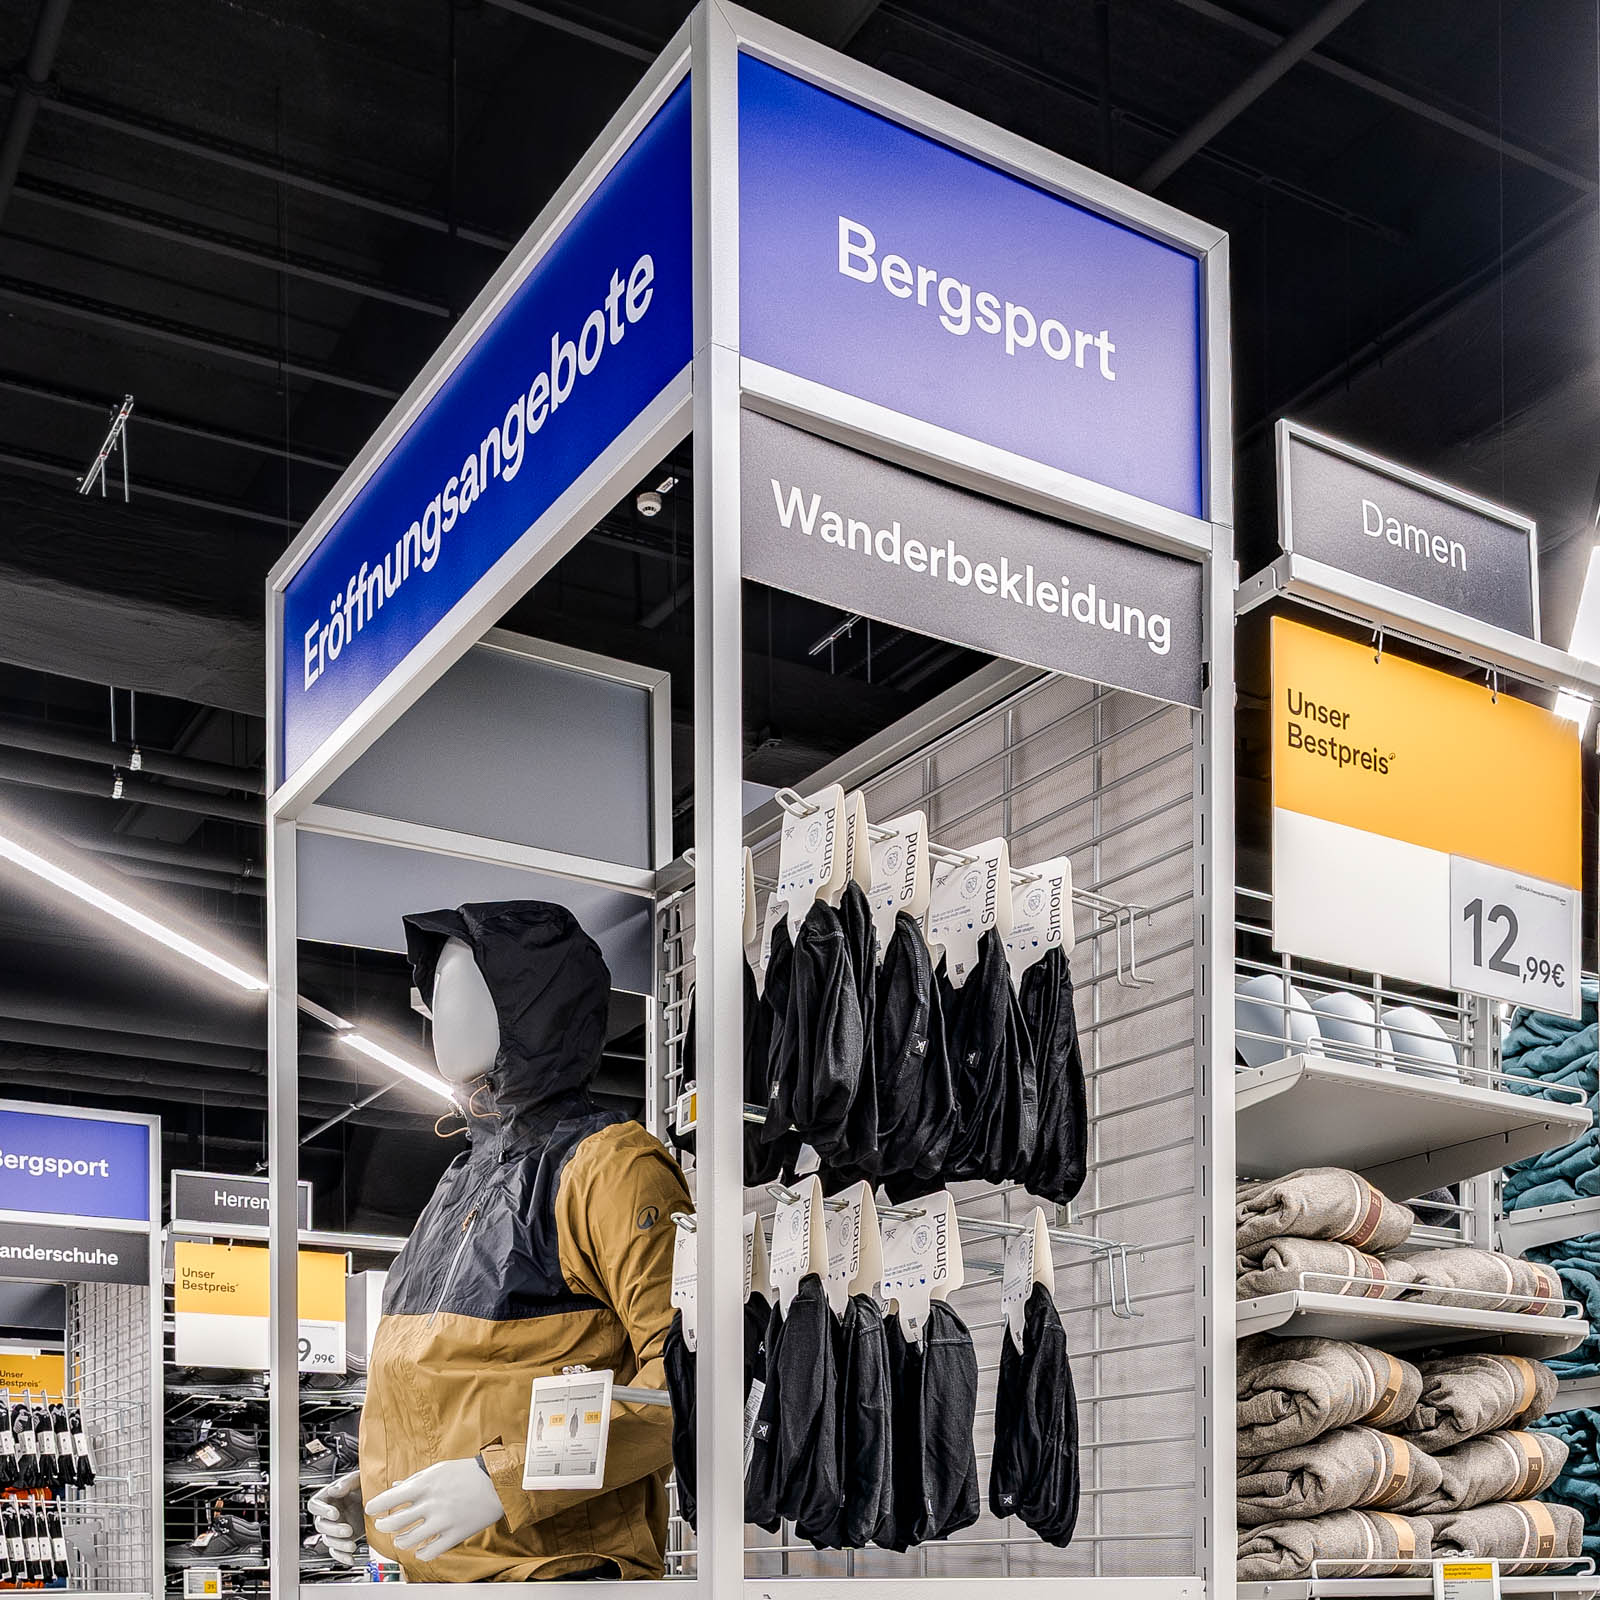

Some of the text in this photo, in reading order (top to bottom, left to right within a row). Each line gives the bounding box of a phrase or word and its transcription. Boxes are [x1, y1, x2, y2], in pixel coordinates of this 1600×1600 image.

[837, 216, 1116, 381] Bergsport
[303, 254, 654, 693] Eröffnungsangebote
[771, 479, 1172, 655] Wanderbekleidung
[1362, 499, 1468, 572] Damen
[1287, 688, 1350, 731] Unser
[820, 807, 836, 880] Simond
[900, 832, 918, 901] Simond
[981, 857, 999, 925] Simond
[1047, 876, 1063, 943] Simond
[1463, 896, 1565, 989] 12,99€
[214, 1190, 270, 1211] Herren
[800, 1198, 811, 1270] Simond
[743, 1233, 754, 1303] Simond
[850, 1203, 861, 1274] Simond
[933, 1212, 947, 1281] Simond
[182, 1267, 215, 1280] Unser
[0, 1370, 24, 1379] Unser
[1530, 1462, 1540, 1472] XL
[1542, 1541, 1551, 1550] XL
